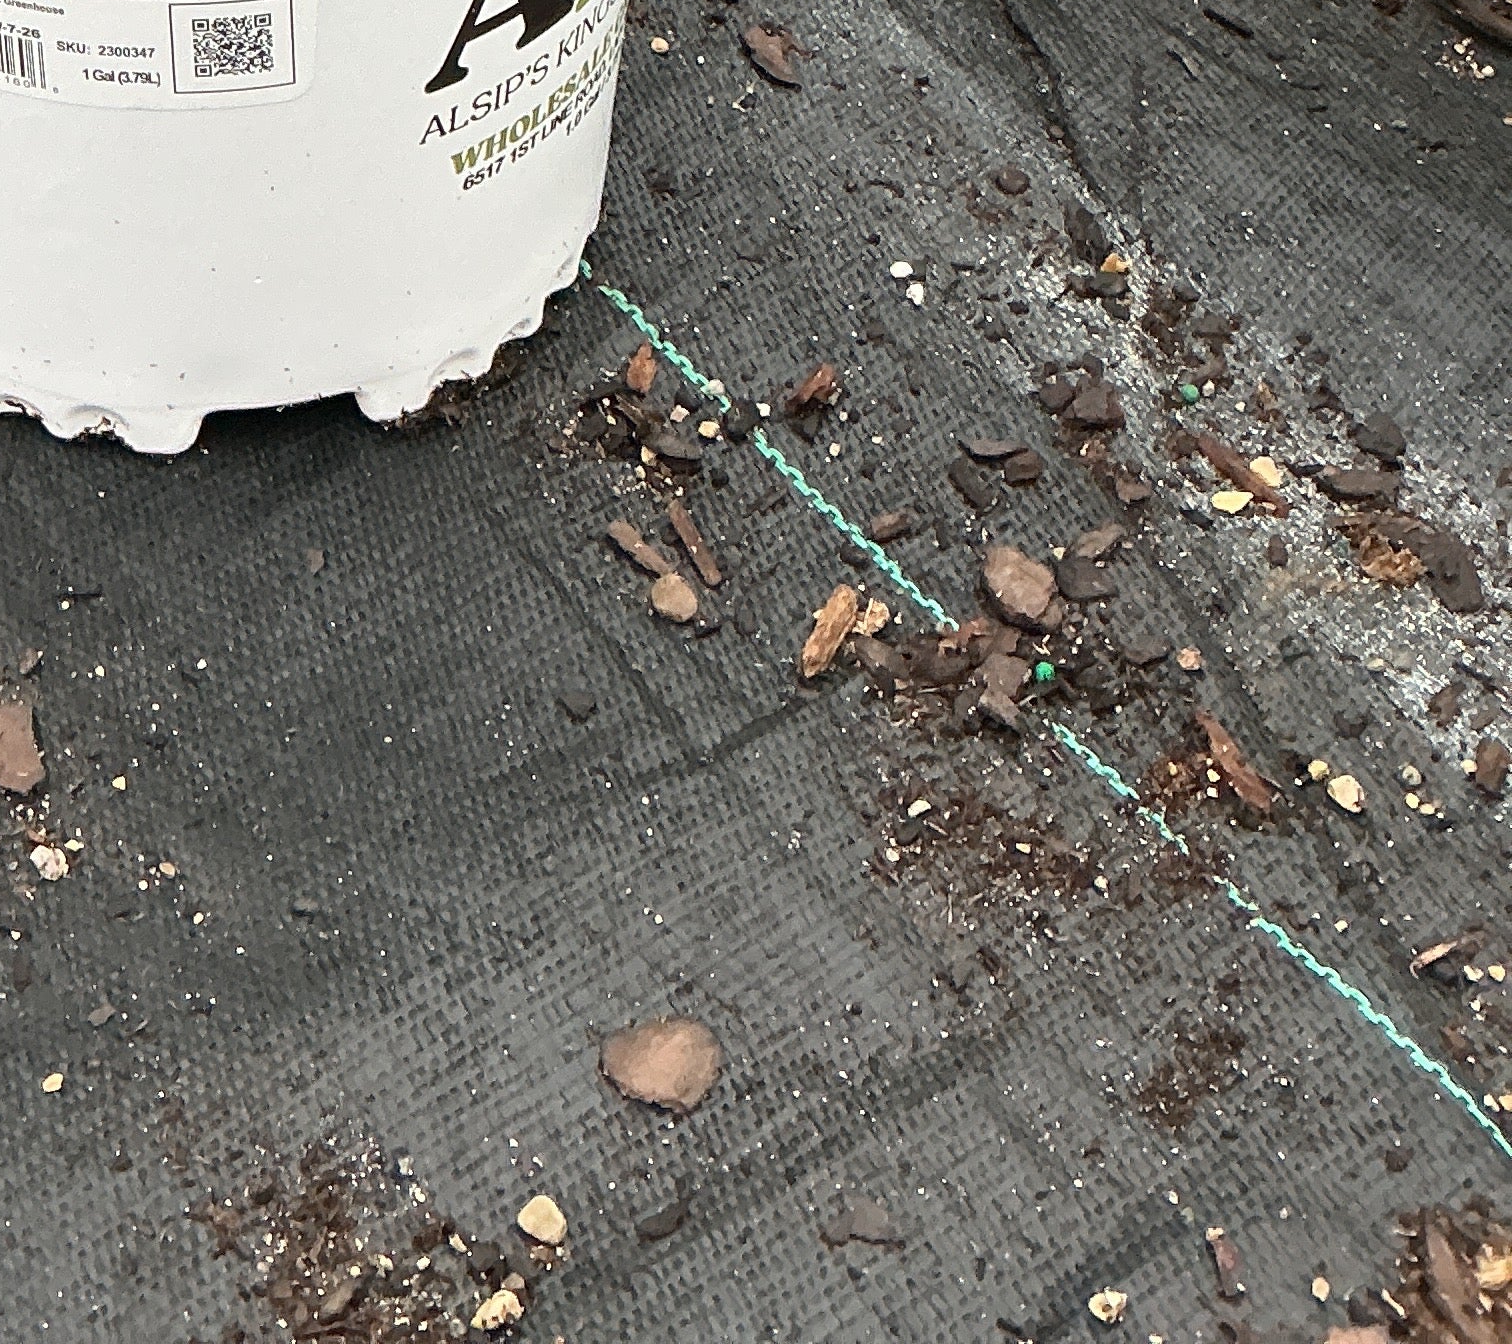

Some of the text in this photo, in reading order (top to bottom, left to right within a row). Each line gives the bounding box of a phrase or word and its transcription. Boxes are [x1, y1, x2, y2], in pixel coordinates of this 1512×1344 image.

[56, 41, 156, 59] SKU: 2300347
[82, 69, 161, 87] 1 Gal (3.79L)
[419, 53, 550, 145] ALSIP'S
[463, 156, 505, 191] 6517
[511, 132, 538, 163] 1ST
[541, 101, 574, 141] LINE
